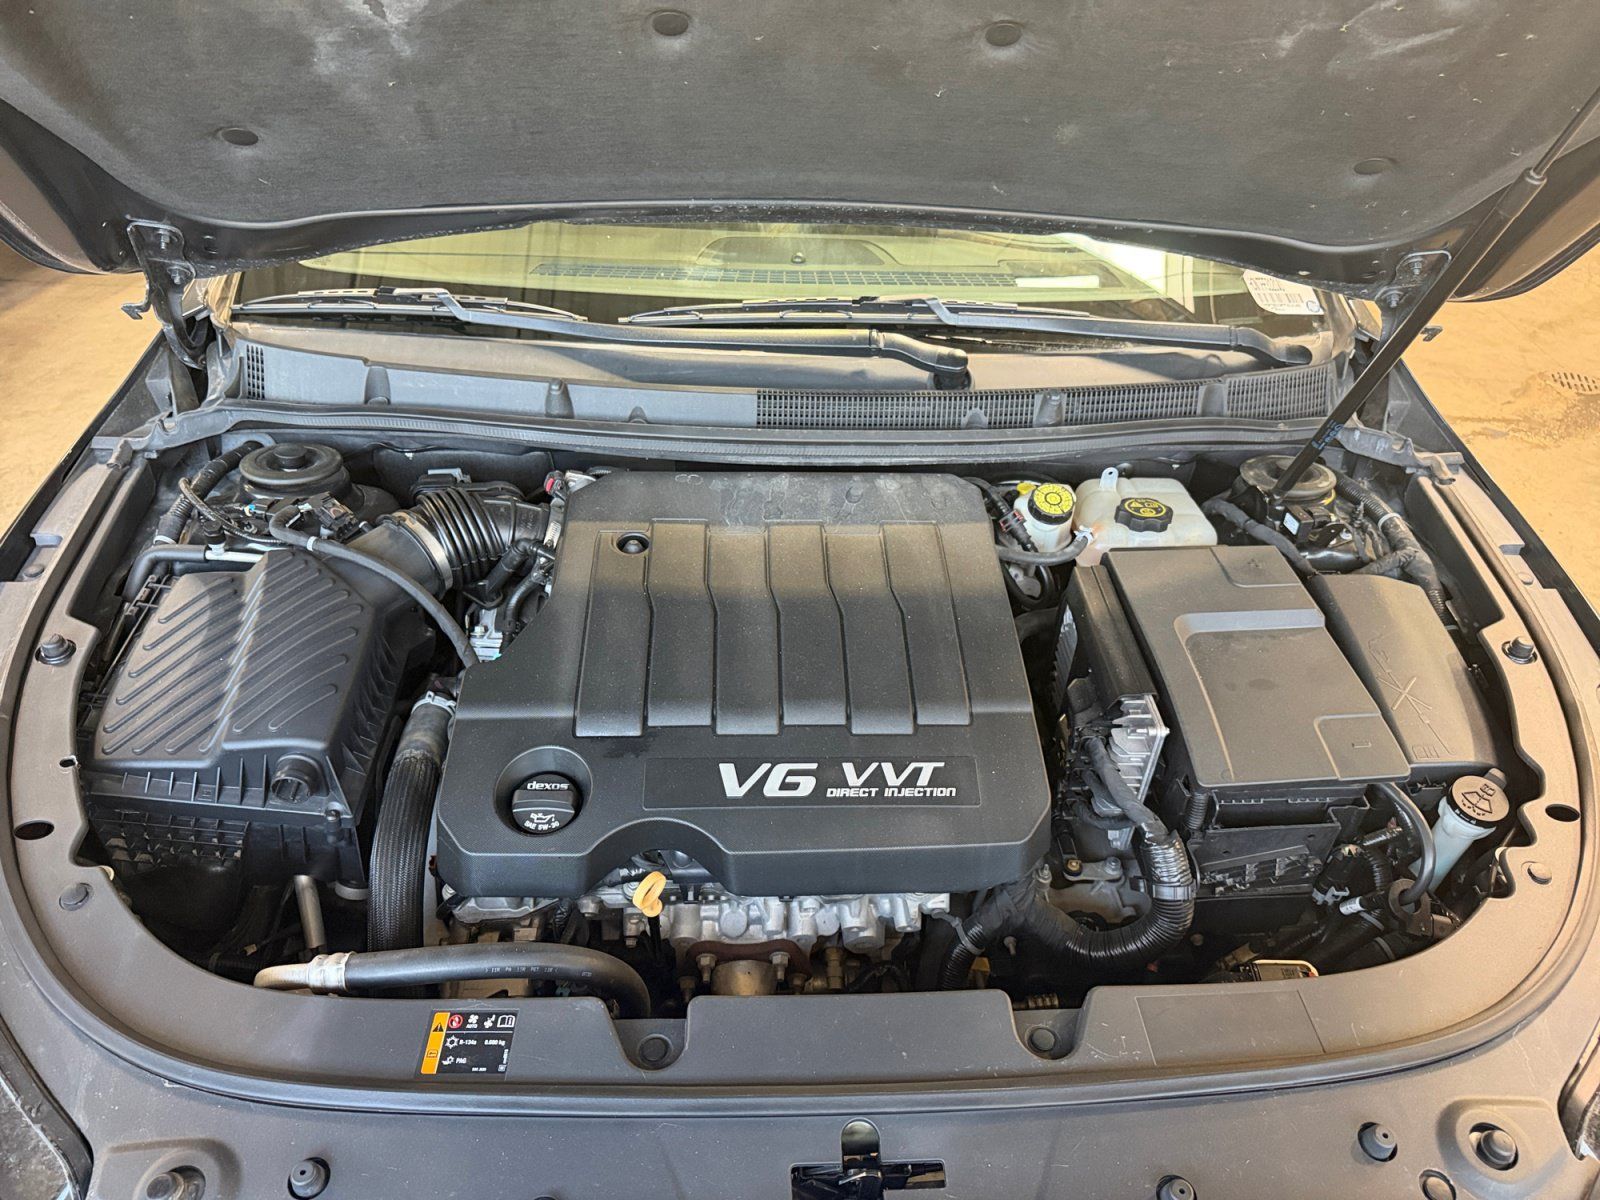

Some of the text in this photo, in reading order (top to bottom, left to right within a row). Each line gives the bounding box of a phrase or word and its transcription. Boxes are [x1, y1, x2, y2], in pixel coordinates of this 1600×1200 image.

[527, 781, 569, 790] dexos
[718, 762, 945, 798] V6 VVT
[826, 787, 957, 798] DIRECT INJECTION
